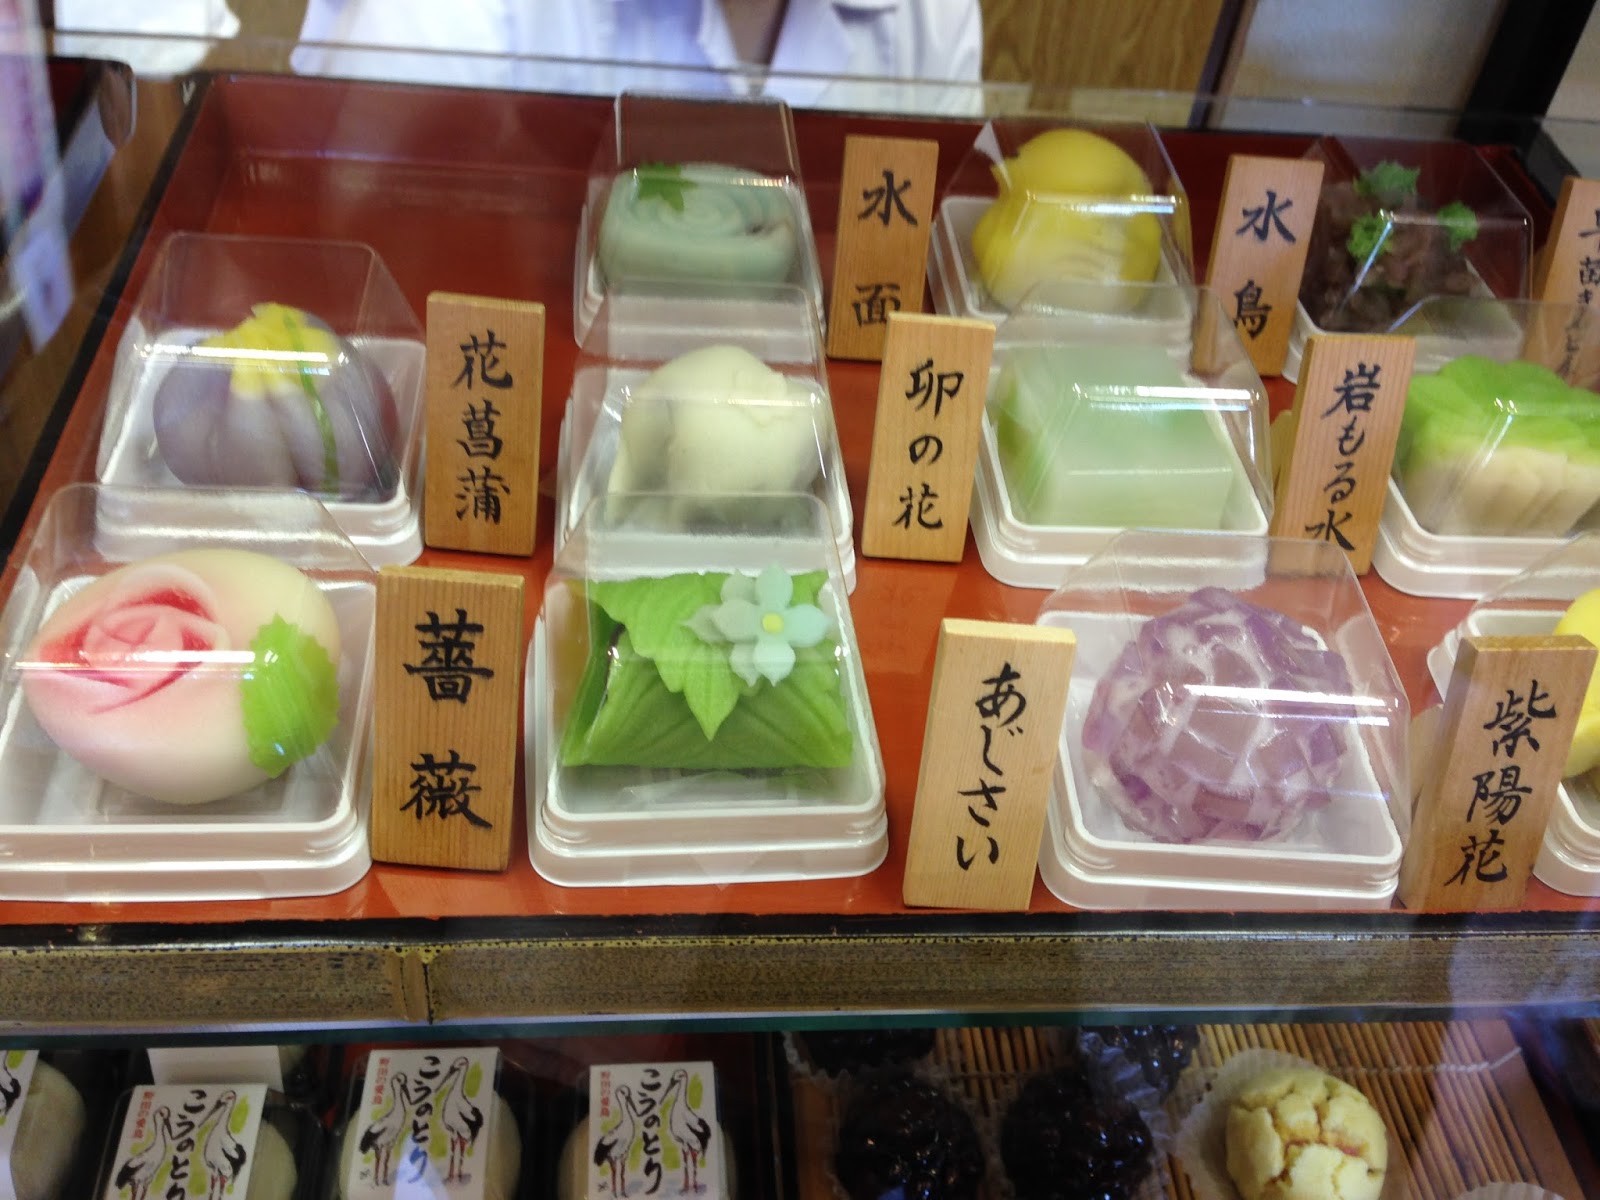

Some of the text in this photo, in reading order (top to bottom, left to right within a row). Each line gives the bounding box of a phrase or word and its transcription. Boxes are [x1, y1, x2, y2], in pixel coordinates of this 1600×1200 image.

[851, 169, 918, 327] 水面
[1233, 190, 1297, 339] 水鳥
[451, 329, 514, 525] 花菖蒲
[892, 357, 964, 531] 卯の花
[1304, 361, 1382, 552] 岩もる水
[400, 608, 495, 831] 薔薇
[955, 662, 1028, 872] あじさい
[1444, 679, 1557, 887] 紫陽花
[408, 1055, 441, 1184] こうのとり
[637, 1068, 662, 1195] こうのとり
